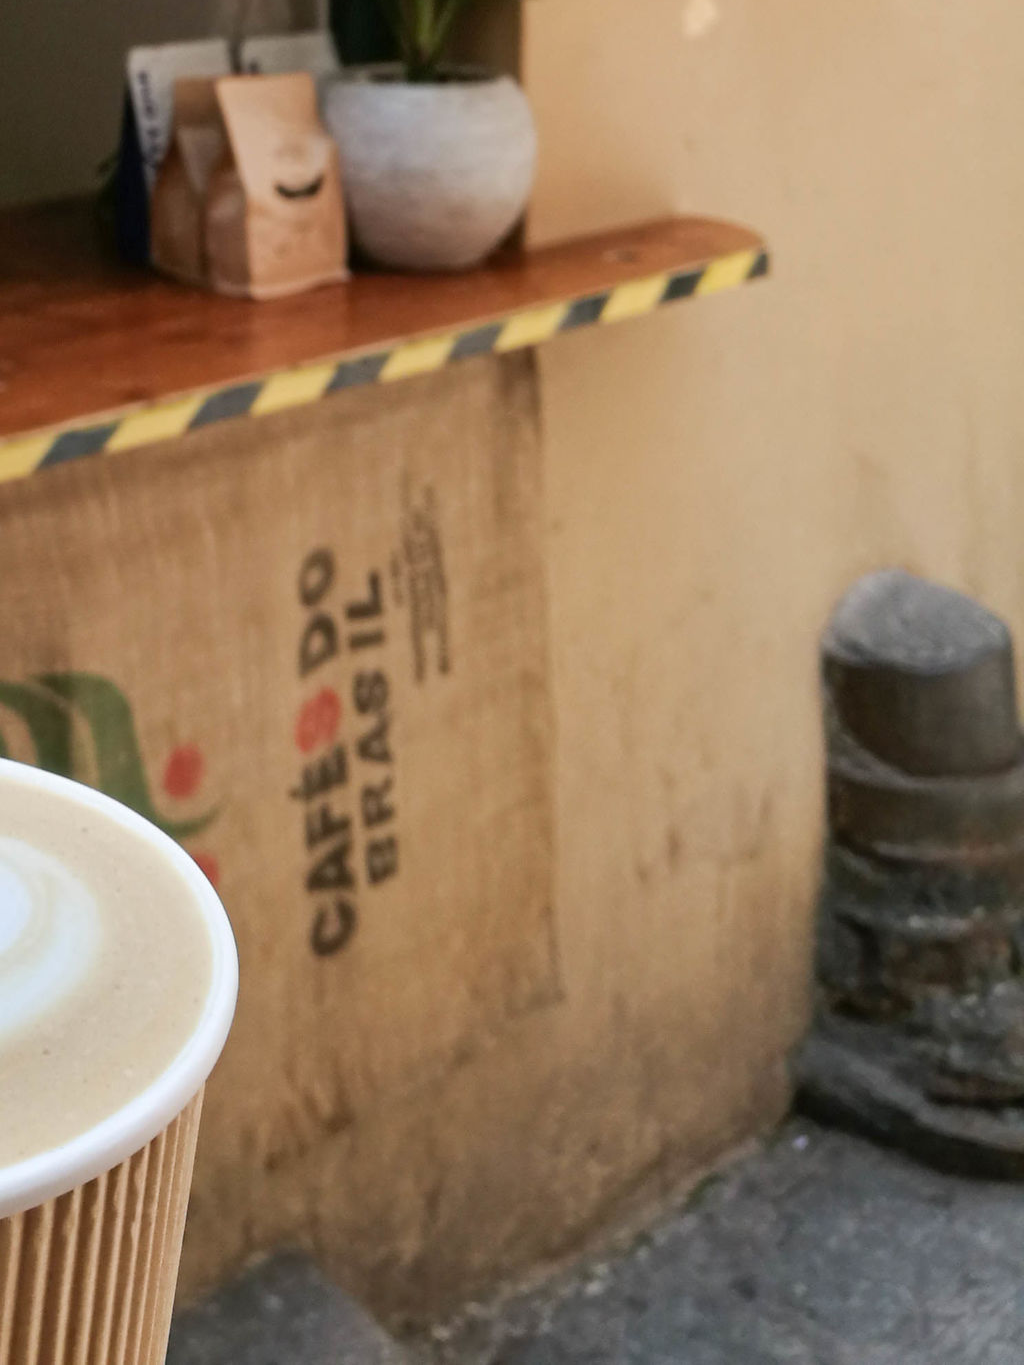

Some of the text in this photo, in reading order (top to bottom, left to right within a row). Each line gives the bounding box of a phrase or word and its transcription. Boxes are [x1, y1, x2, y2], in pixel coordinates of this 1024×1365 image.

[289, 546, 358, 959] CAFÉ DO
[344, 568, 400, 888] BRASIL
